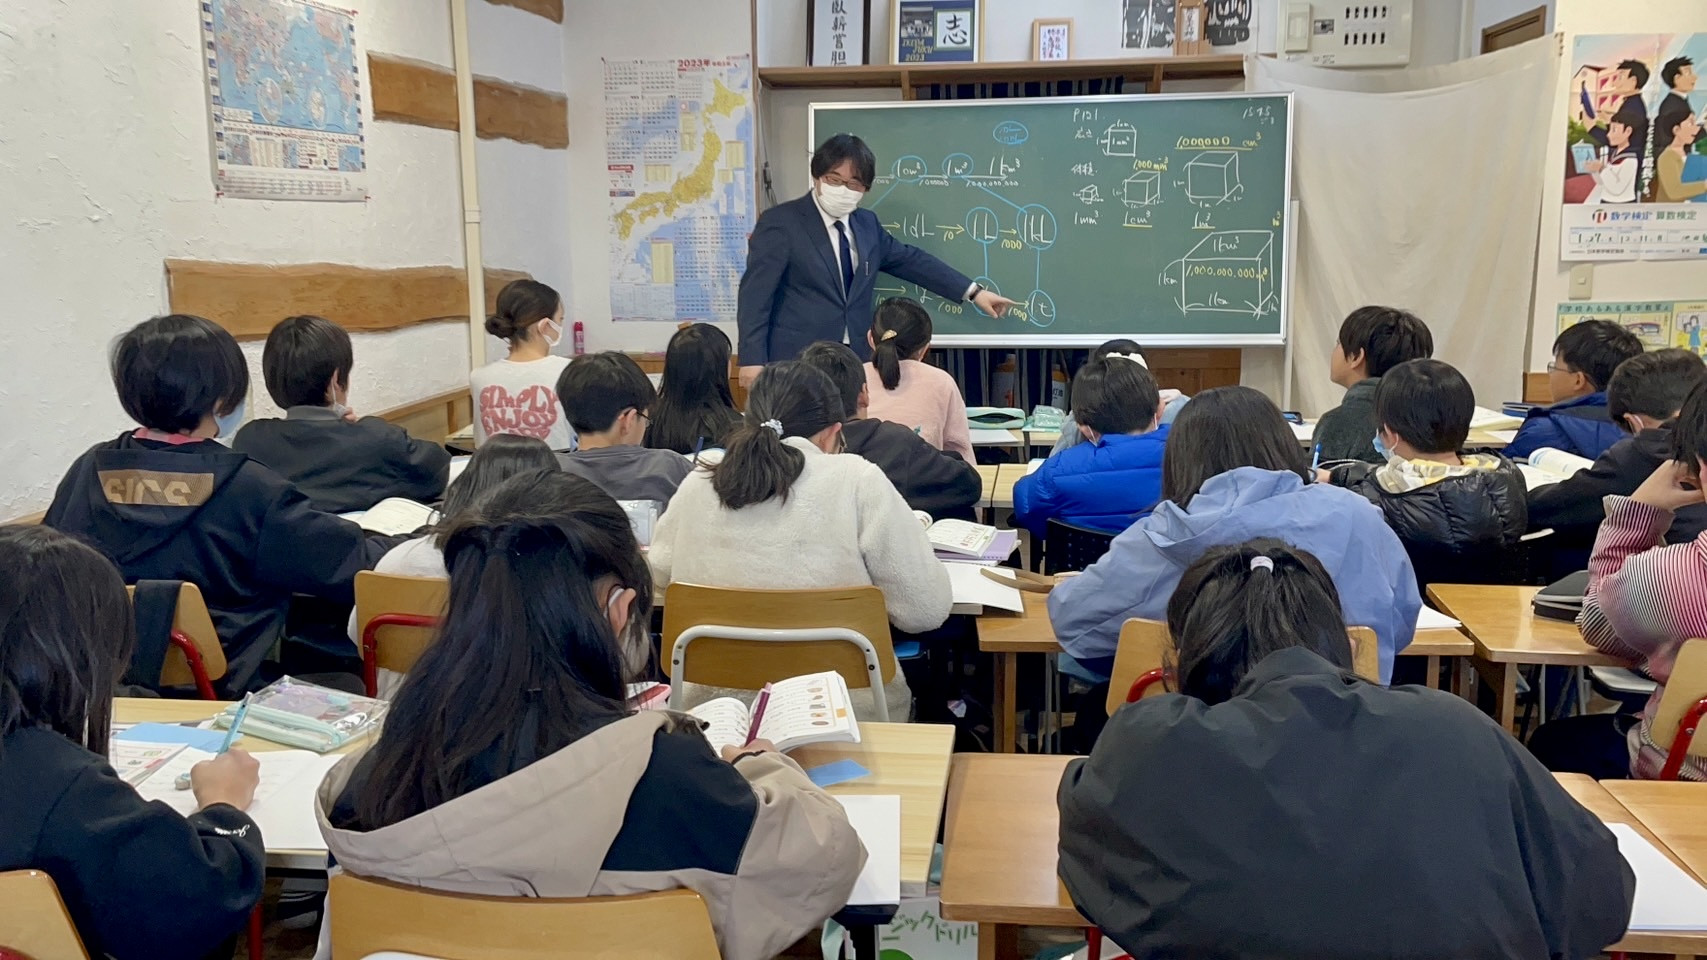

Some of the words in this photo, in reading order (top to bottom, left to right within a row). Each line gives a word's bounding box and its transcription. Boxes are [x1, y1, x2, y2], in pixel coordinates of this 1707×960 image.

[943, 13, 967, 45] 志
[1611, 211, 1652, 221] 数学検定
[1655, 211, 1697, 221] 算数検定
